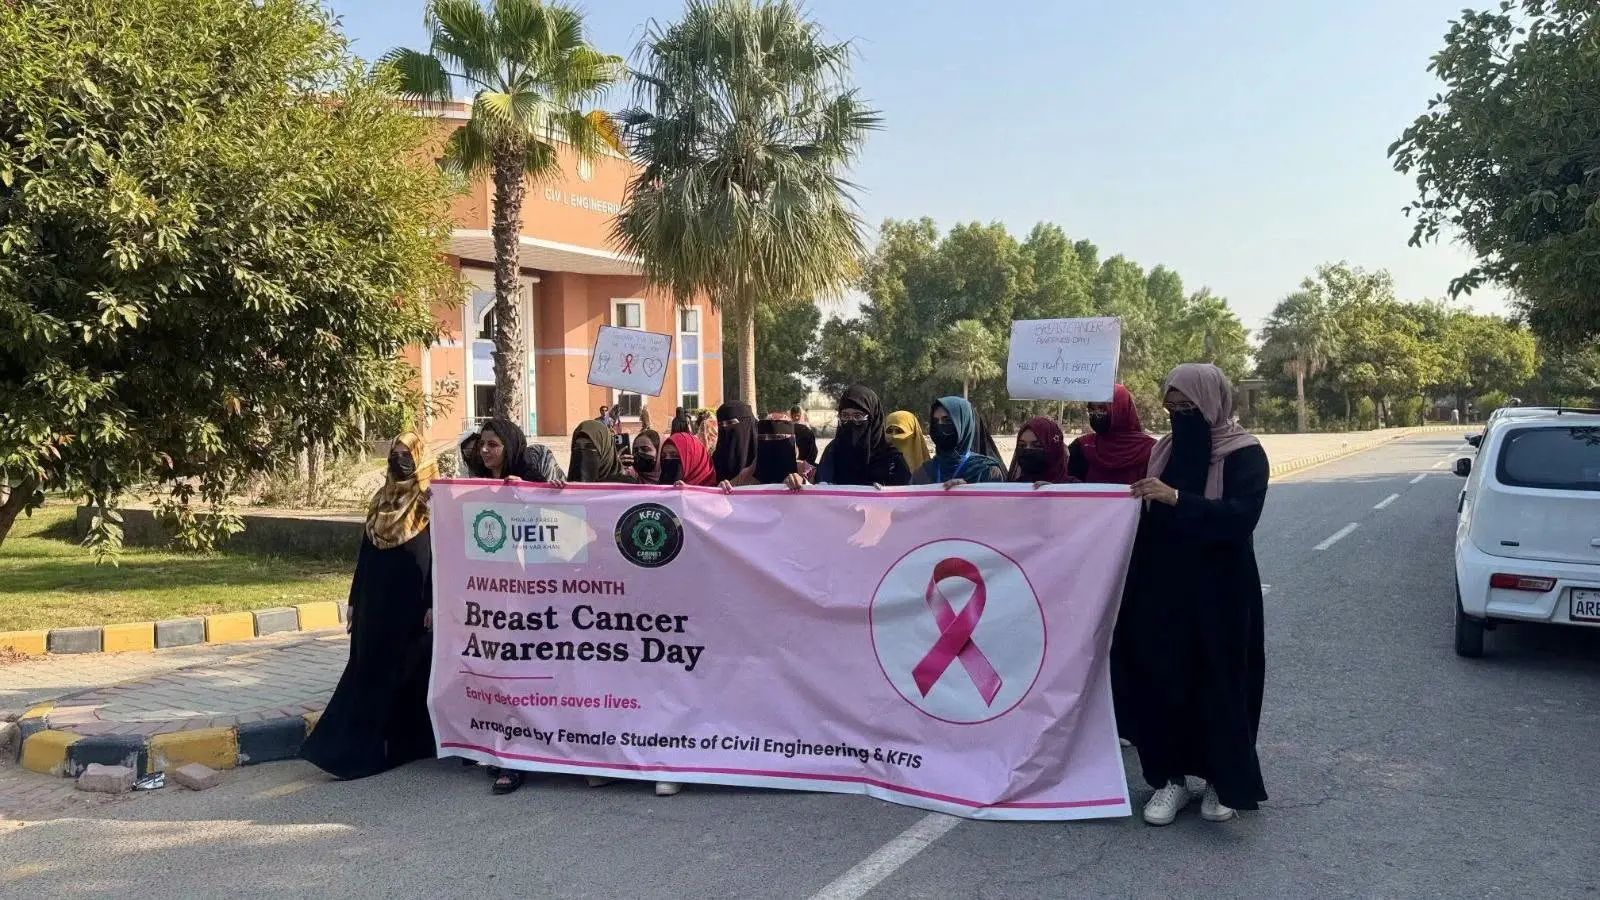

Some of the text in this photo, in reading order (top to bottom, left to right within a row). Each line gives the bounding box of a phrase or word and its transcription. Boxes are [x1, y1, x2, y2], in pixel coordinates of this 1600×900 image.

[639, 510, 661, 521] KFIS
[511, 525, 559, 542] UEIT
[466, 575, 625, 595] AWARENESS MONTH
[464, 601, 689, 633] Breast Cancer
[461, 632, 706, 672] Awareness Day
[466, 686, 642, 710] Early detection saves lives.
[470, 718, 923, 769] Arranged by Female Students of Civil Engineering & KFIS
